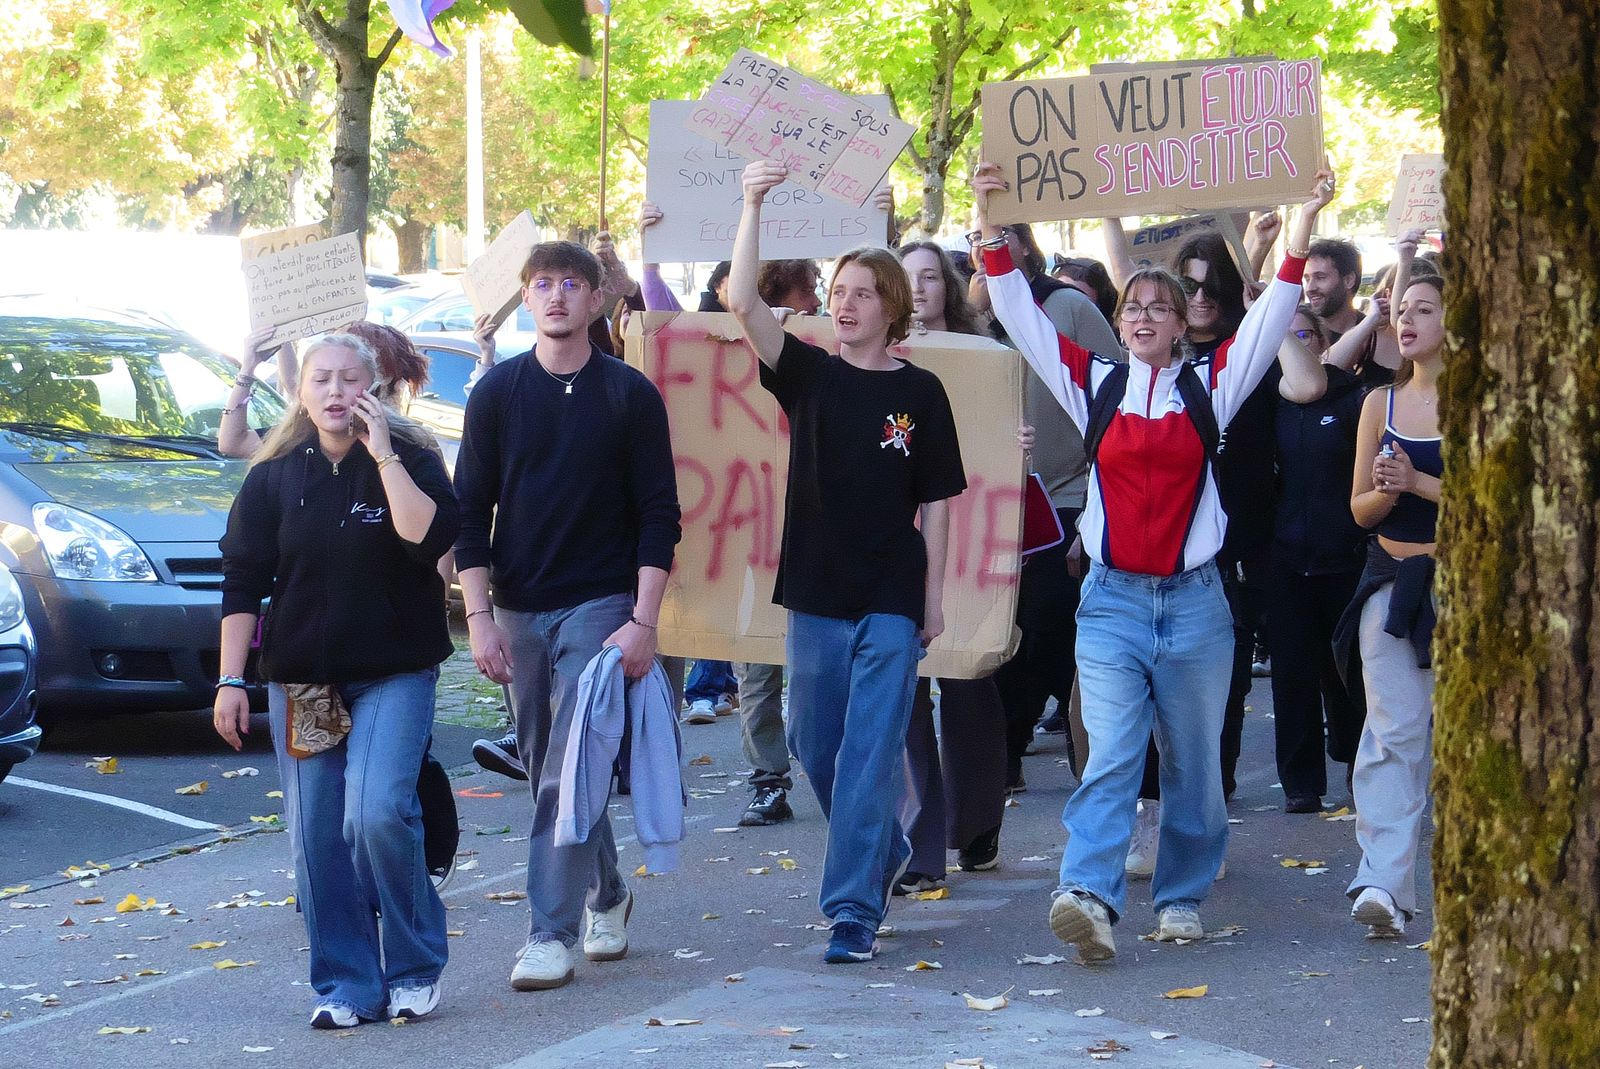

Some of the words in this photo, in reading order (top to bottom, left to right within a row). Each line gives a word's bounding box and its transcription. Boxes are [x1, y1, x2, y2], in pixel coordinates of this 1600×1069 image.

[722, 72, 745, 87] LA
[749, 84, 809, 122] DOUCHE
[808, 117, 848, 141] C'EST
[848, 136, 886, 160] BIEN
[738, 56, 789, 91] FAIRE
[851, 109, 890, 136] SOUS
[1008, 84, 1077, 147] ON
[1100, 71, 1192, 133] VEUT
[693, 108, 810, 172] CAPITALISME
[807, 137, 832, 154] LE
[1016, 147, 1087, 203] PAS
[1093, 119, 1298, 196] S'ENDETTER
[678, 168, 742, 188] SONT
[699, 216, 868, 242] ÉCOTEZ-LES
[305, 252, 356, 274] POLITIQUE
